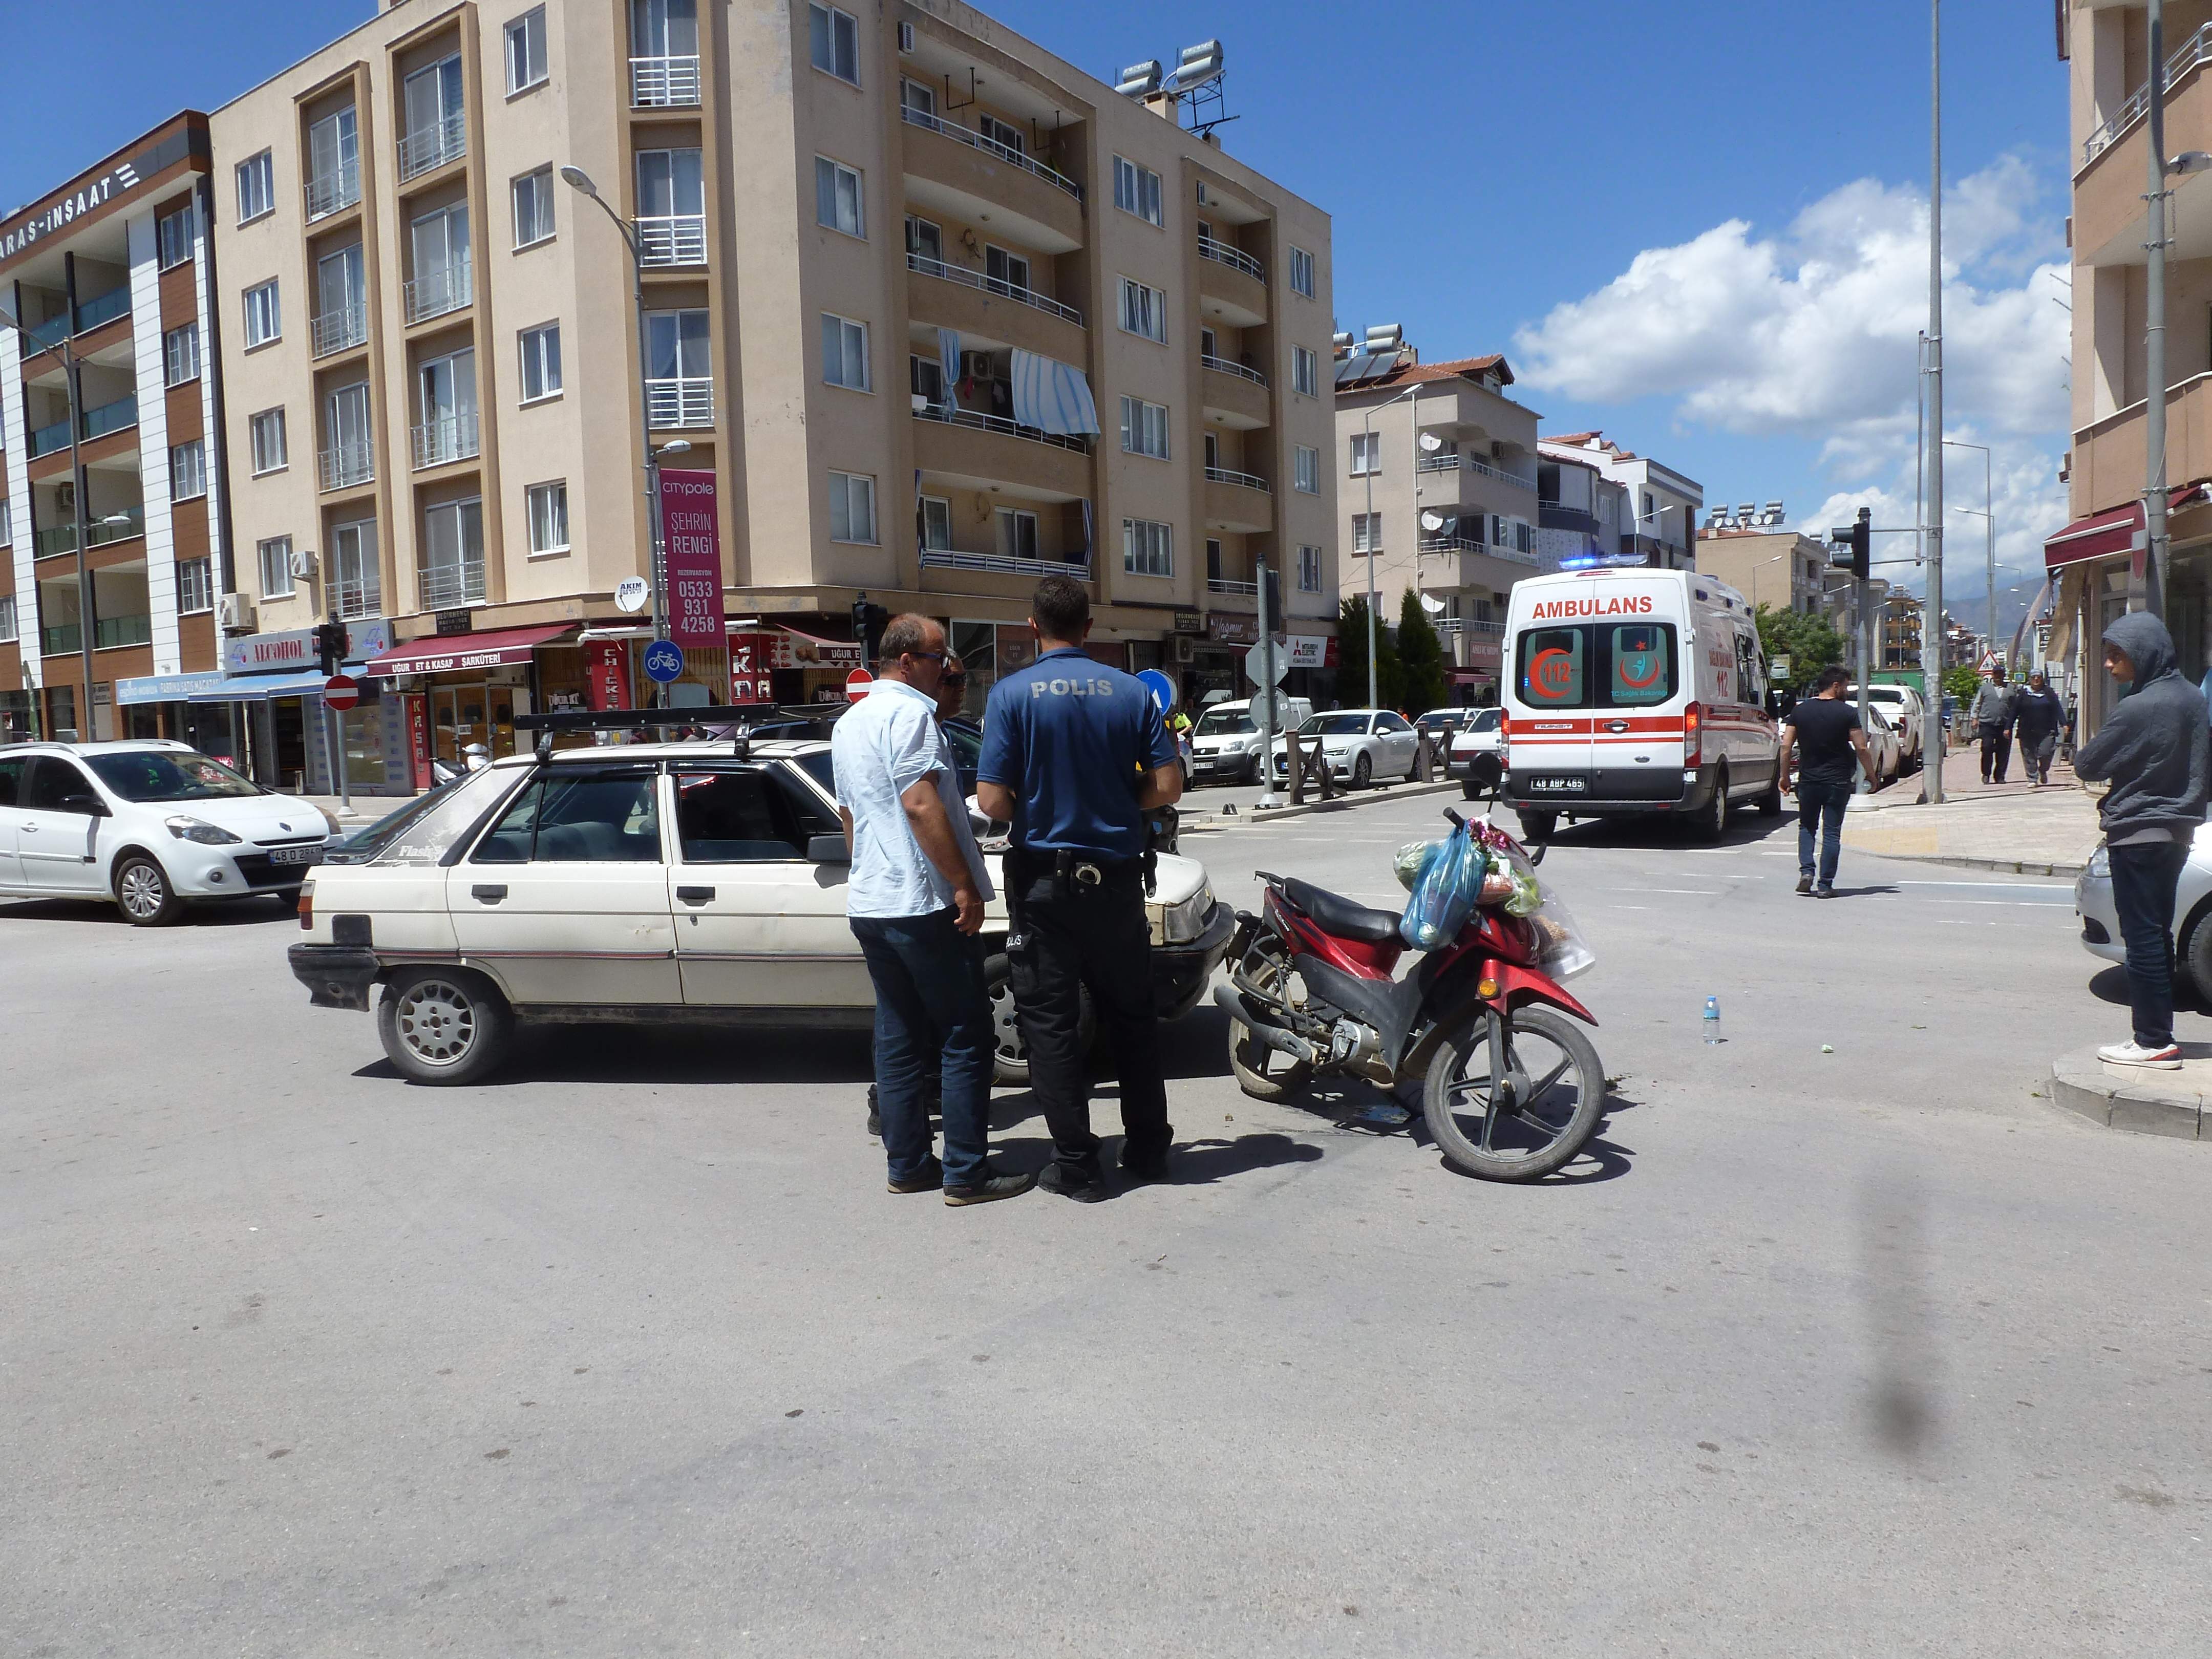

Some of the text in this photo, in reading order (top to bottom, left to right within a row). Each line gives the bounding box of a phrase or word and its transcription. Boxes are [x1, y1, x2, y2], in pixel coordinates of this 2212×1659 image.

[671, 509, 711, 533] ŞEHRİN
[673, 533, 713, 554] RENGİ
[679, 581, 713, 598] 0533
[684, 599, 708, 615] 931
[1532, 595, 1652, 619] AMBULANS
[681, 616, 715, 633] 4258
[831, 648, 852, 658] UĞUR
[392, 653, 500, 673] UĞUR ET & KASAP ŞARKÜTERİ
[1544, 662, 1571, 683] 112
[1536, 779, 1582, 788] 48 ABP 465
[275, 851, 287, 861] 48
[290, 850, 296, 860] D
